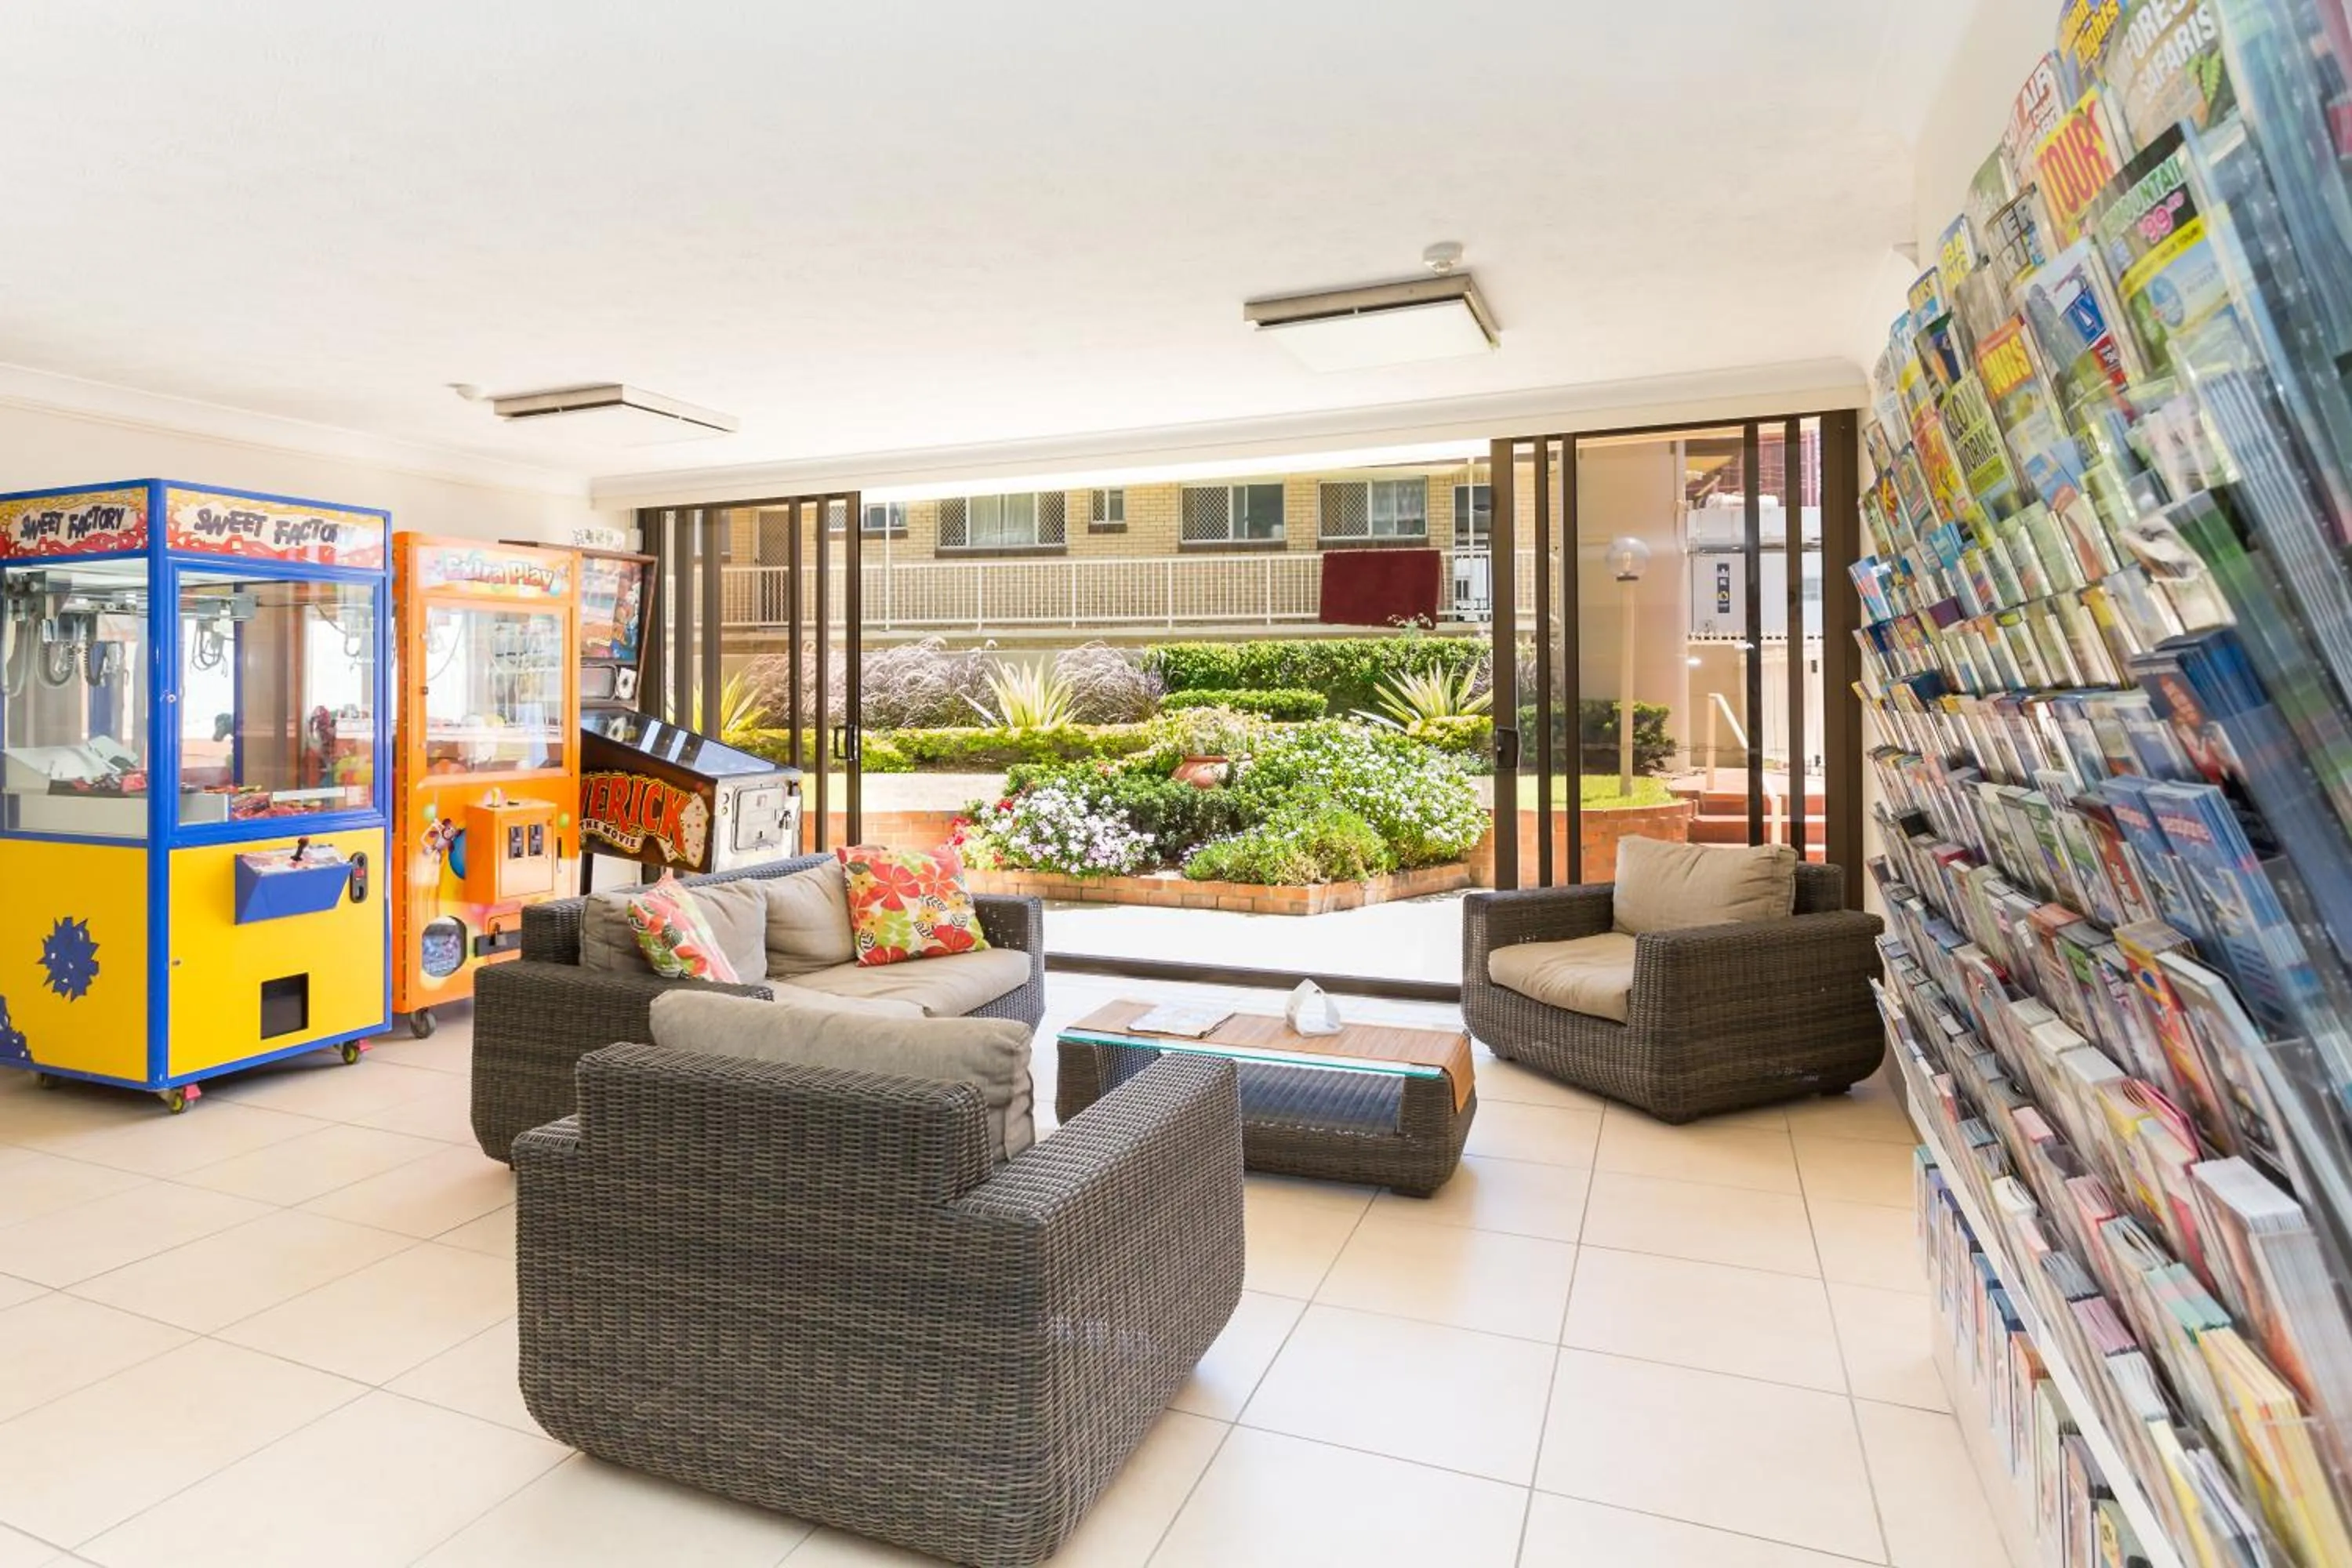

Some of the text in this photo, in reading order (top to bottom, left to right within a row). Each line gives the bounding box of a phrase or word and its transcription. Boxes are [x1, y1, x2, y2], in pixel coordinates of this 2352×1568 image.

[2136, 3, 2216, 103] SAFARIS
[20, 506, 125, 540] SWEET FACTORY
[194, 508, 350, 546] SWEET FACTO
[509, 560, 554, 592] Play
[604, 823, 637, 848] MOVIE
